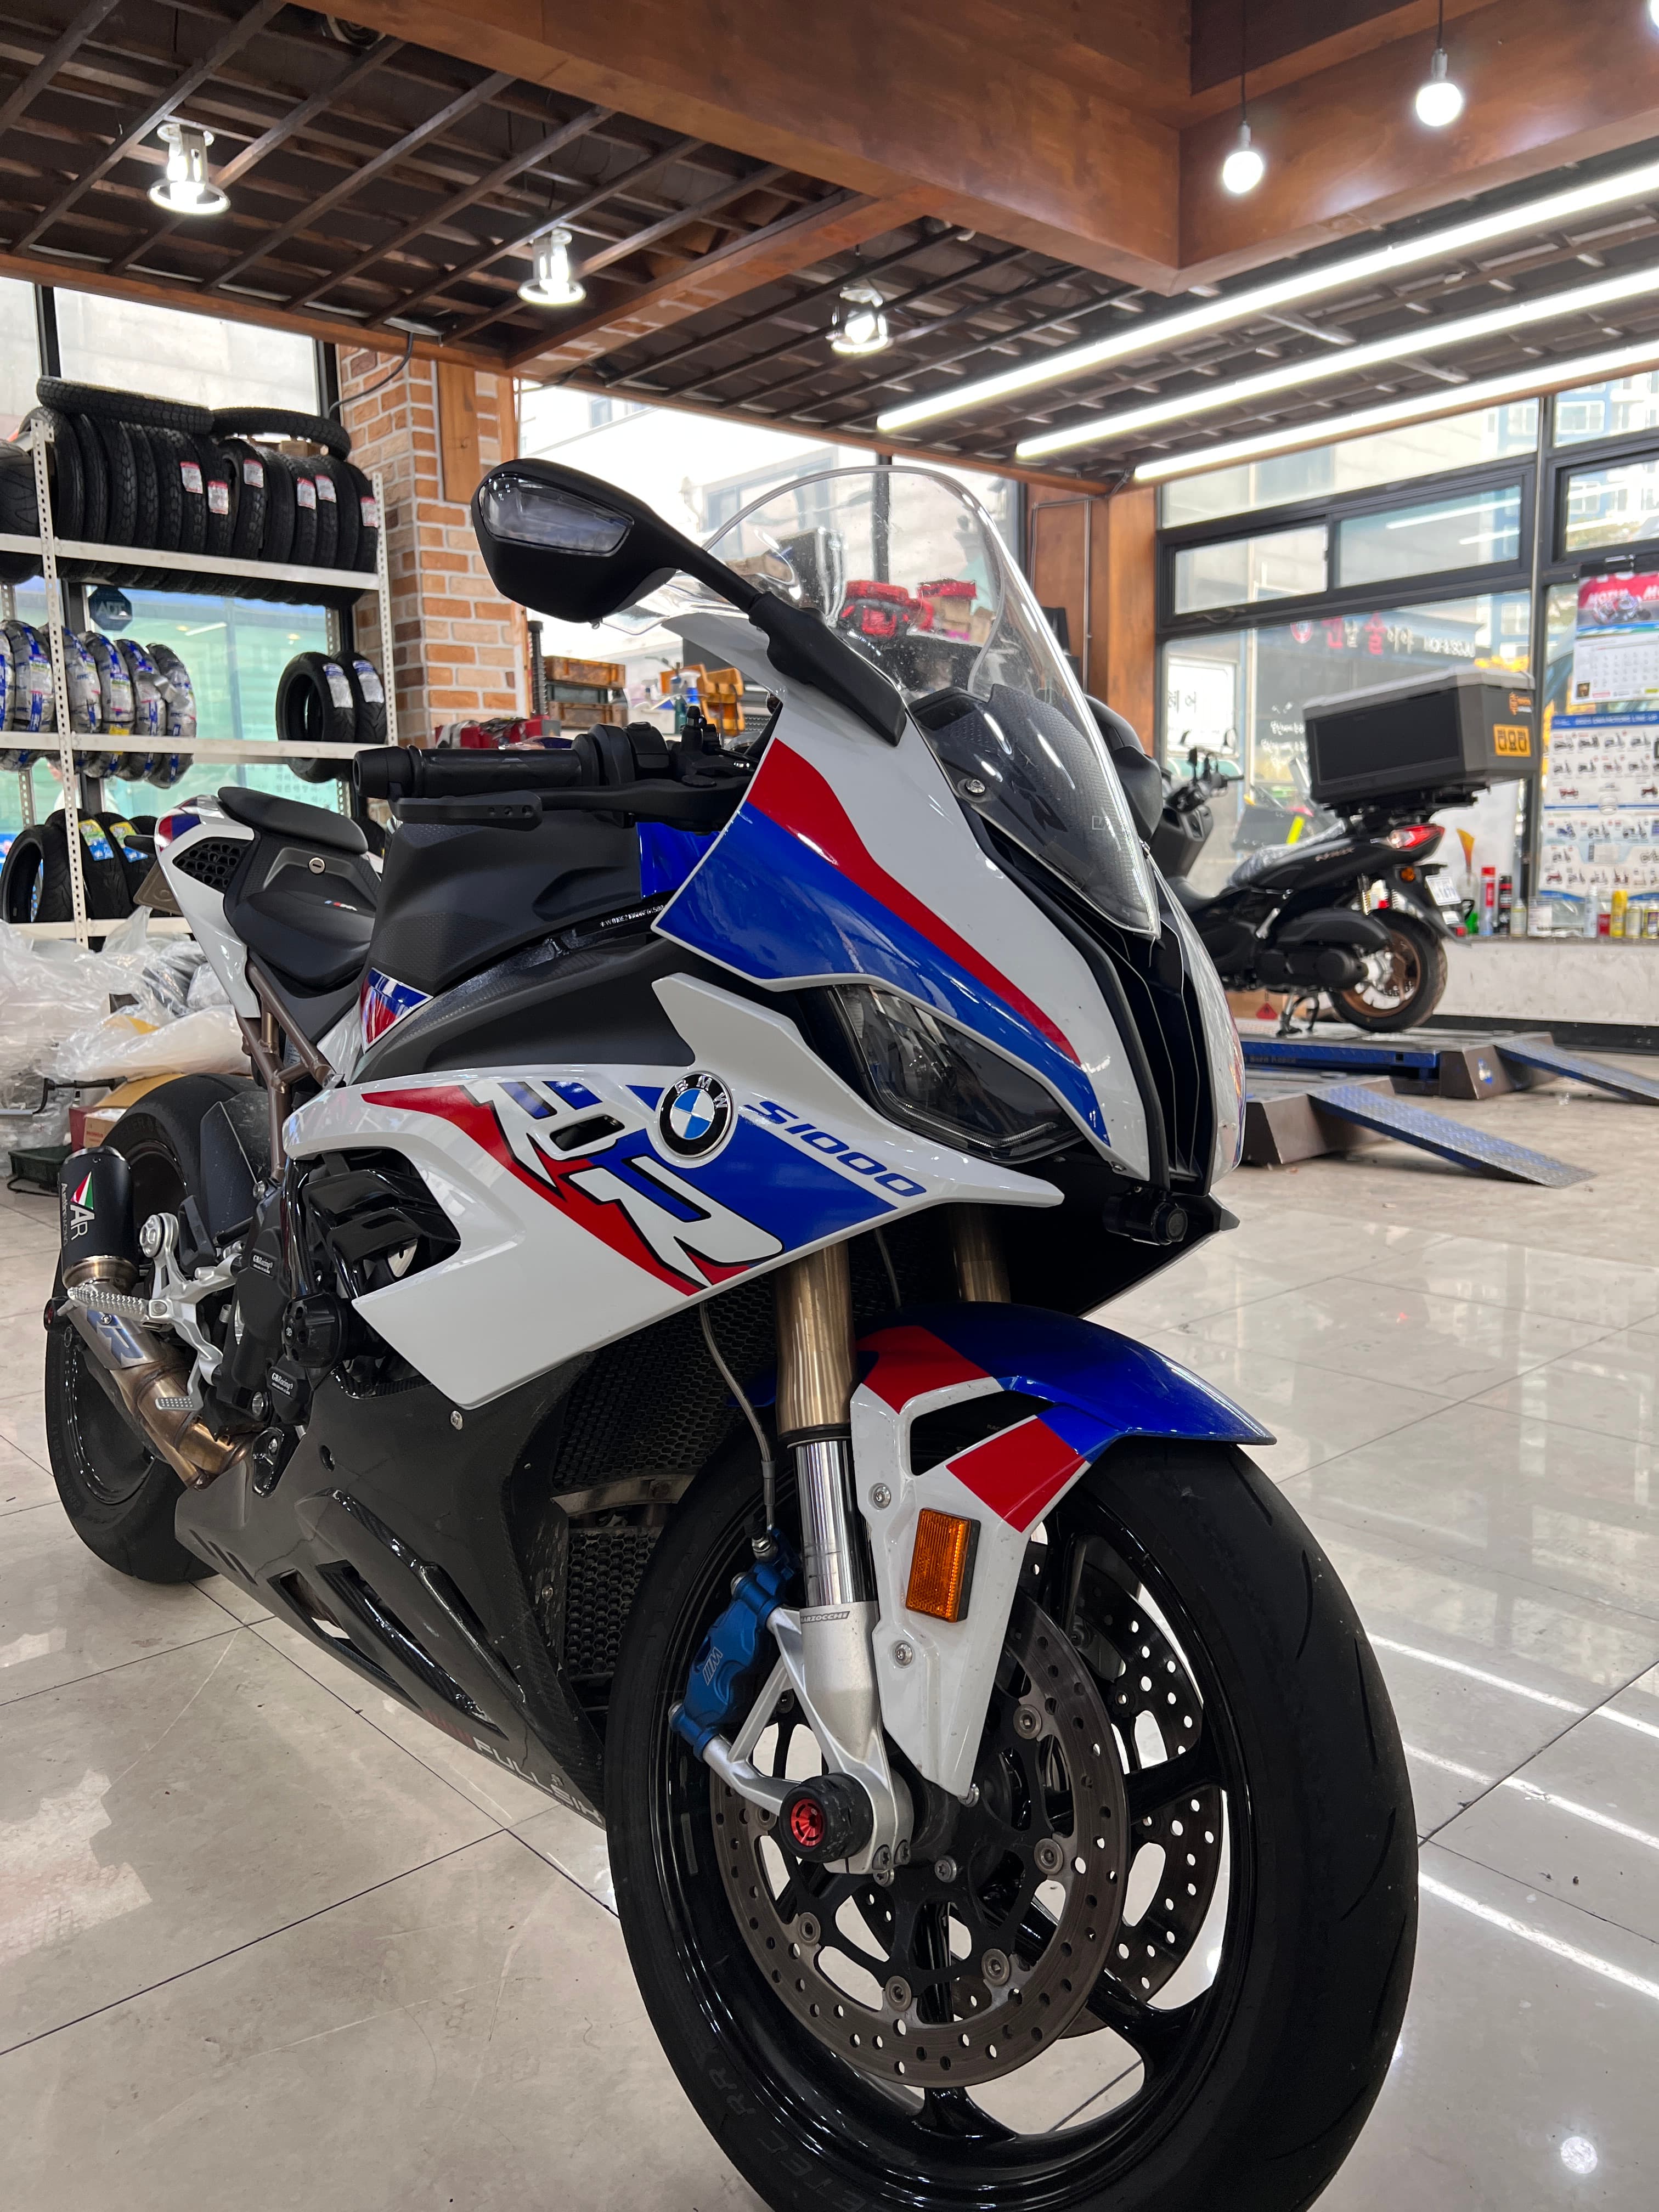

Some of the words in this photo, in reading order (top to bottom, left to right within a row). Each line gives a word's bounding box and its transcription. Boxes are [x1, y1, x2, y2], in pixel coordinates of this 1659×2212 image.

[675, 1074, 730, 1110] BMW
[743, 1099, 928, 1197] S1000
[70, 1204, 95, 1240] AR
